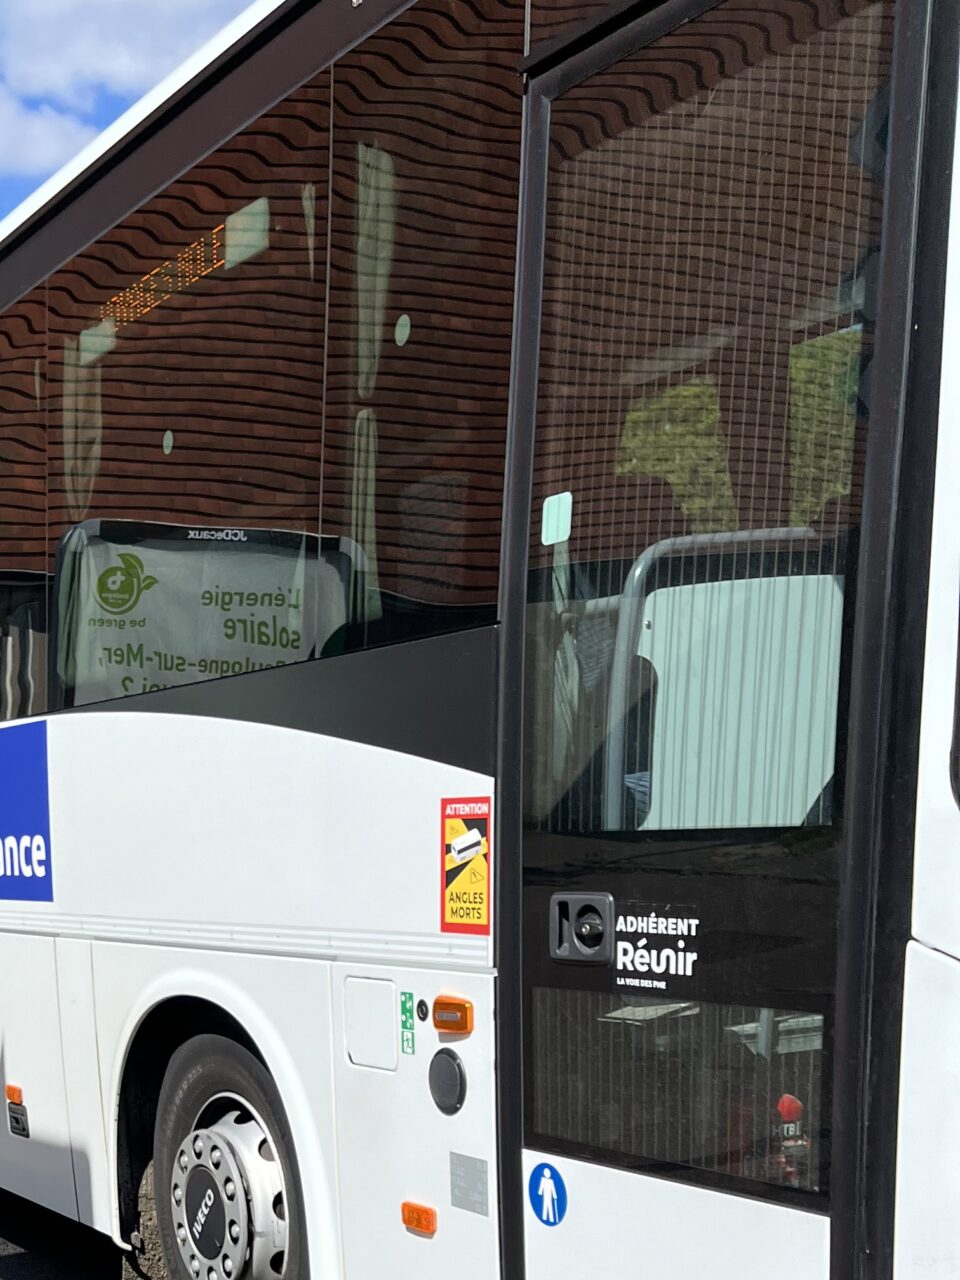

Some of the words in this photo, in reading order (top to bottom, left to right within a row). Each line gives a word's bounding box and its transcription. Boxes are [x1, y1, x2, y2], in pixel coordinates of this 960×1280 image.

[445, 803, 489, 816] ATTENTION
[448, 891, 484, 905] ANGLES
[450, 906, 482, 920] MORTS
[615, 911, 700, 937] ADHÉRENT
[616, 977, 625, 986] LA
[191, 1188, 215, 1240] IVECO
